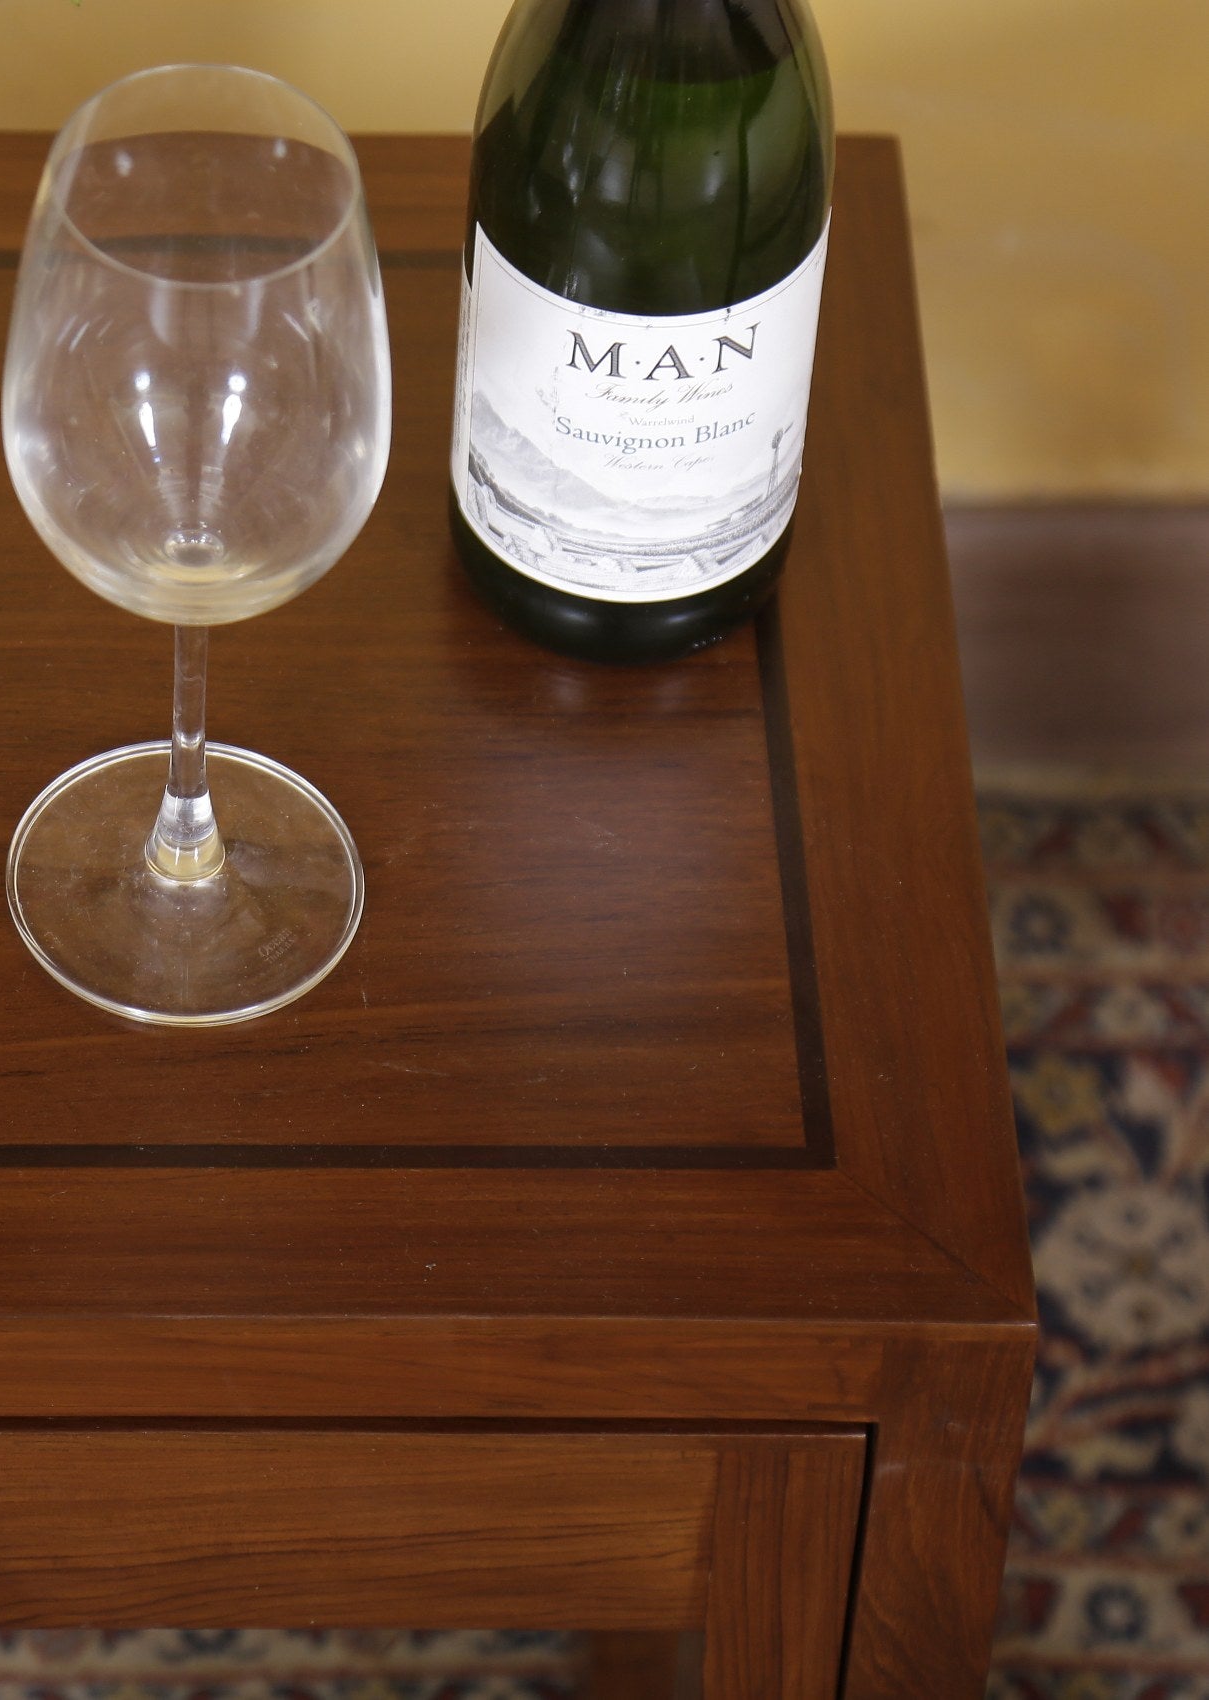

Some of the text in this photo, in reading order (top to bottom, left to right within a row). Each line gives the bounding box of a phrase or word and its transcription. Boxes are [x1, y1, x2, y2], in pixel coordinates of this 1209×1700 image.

[585, 377, 734, 412] Family Wines
[555, 410, 757, 454] Sauvignon Blanc
[628, 414, 695, 427] Warrelwind
[601, 452, 711, 472] Western Cape
